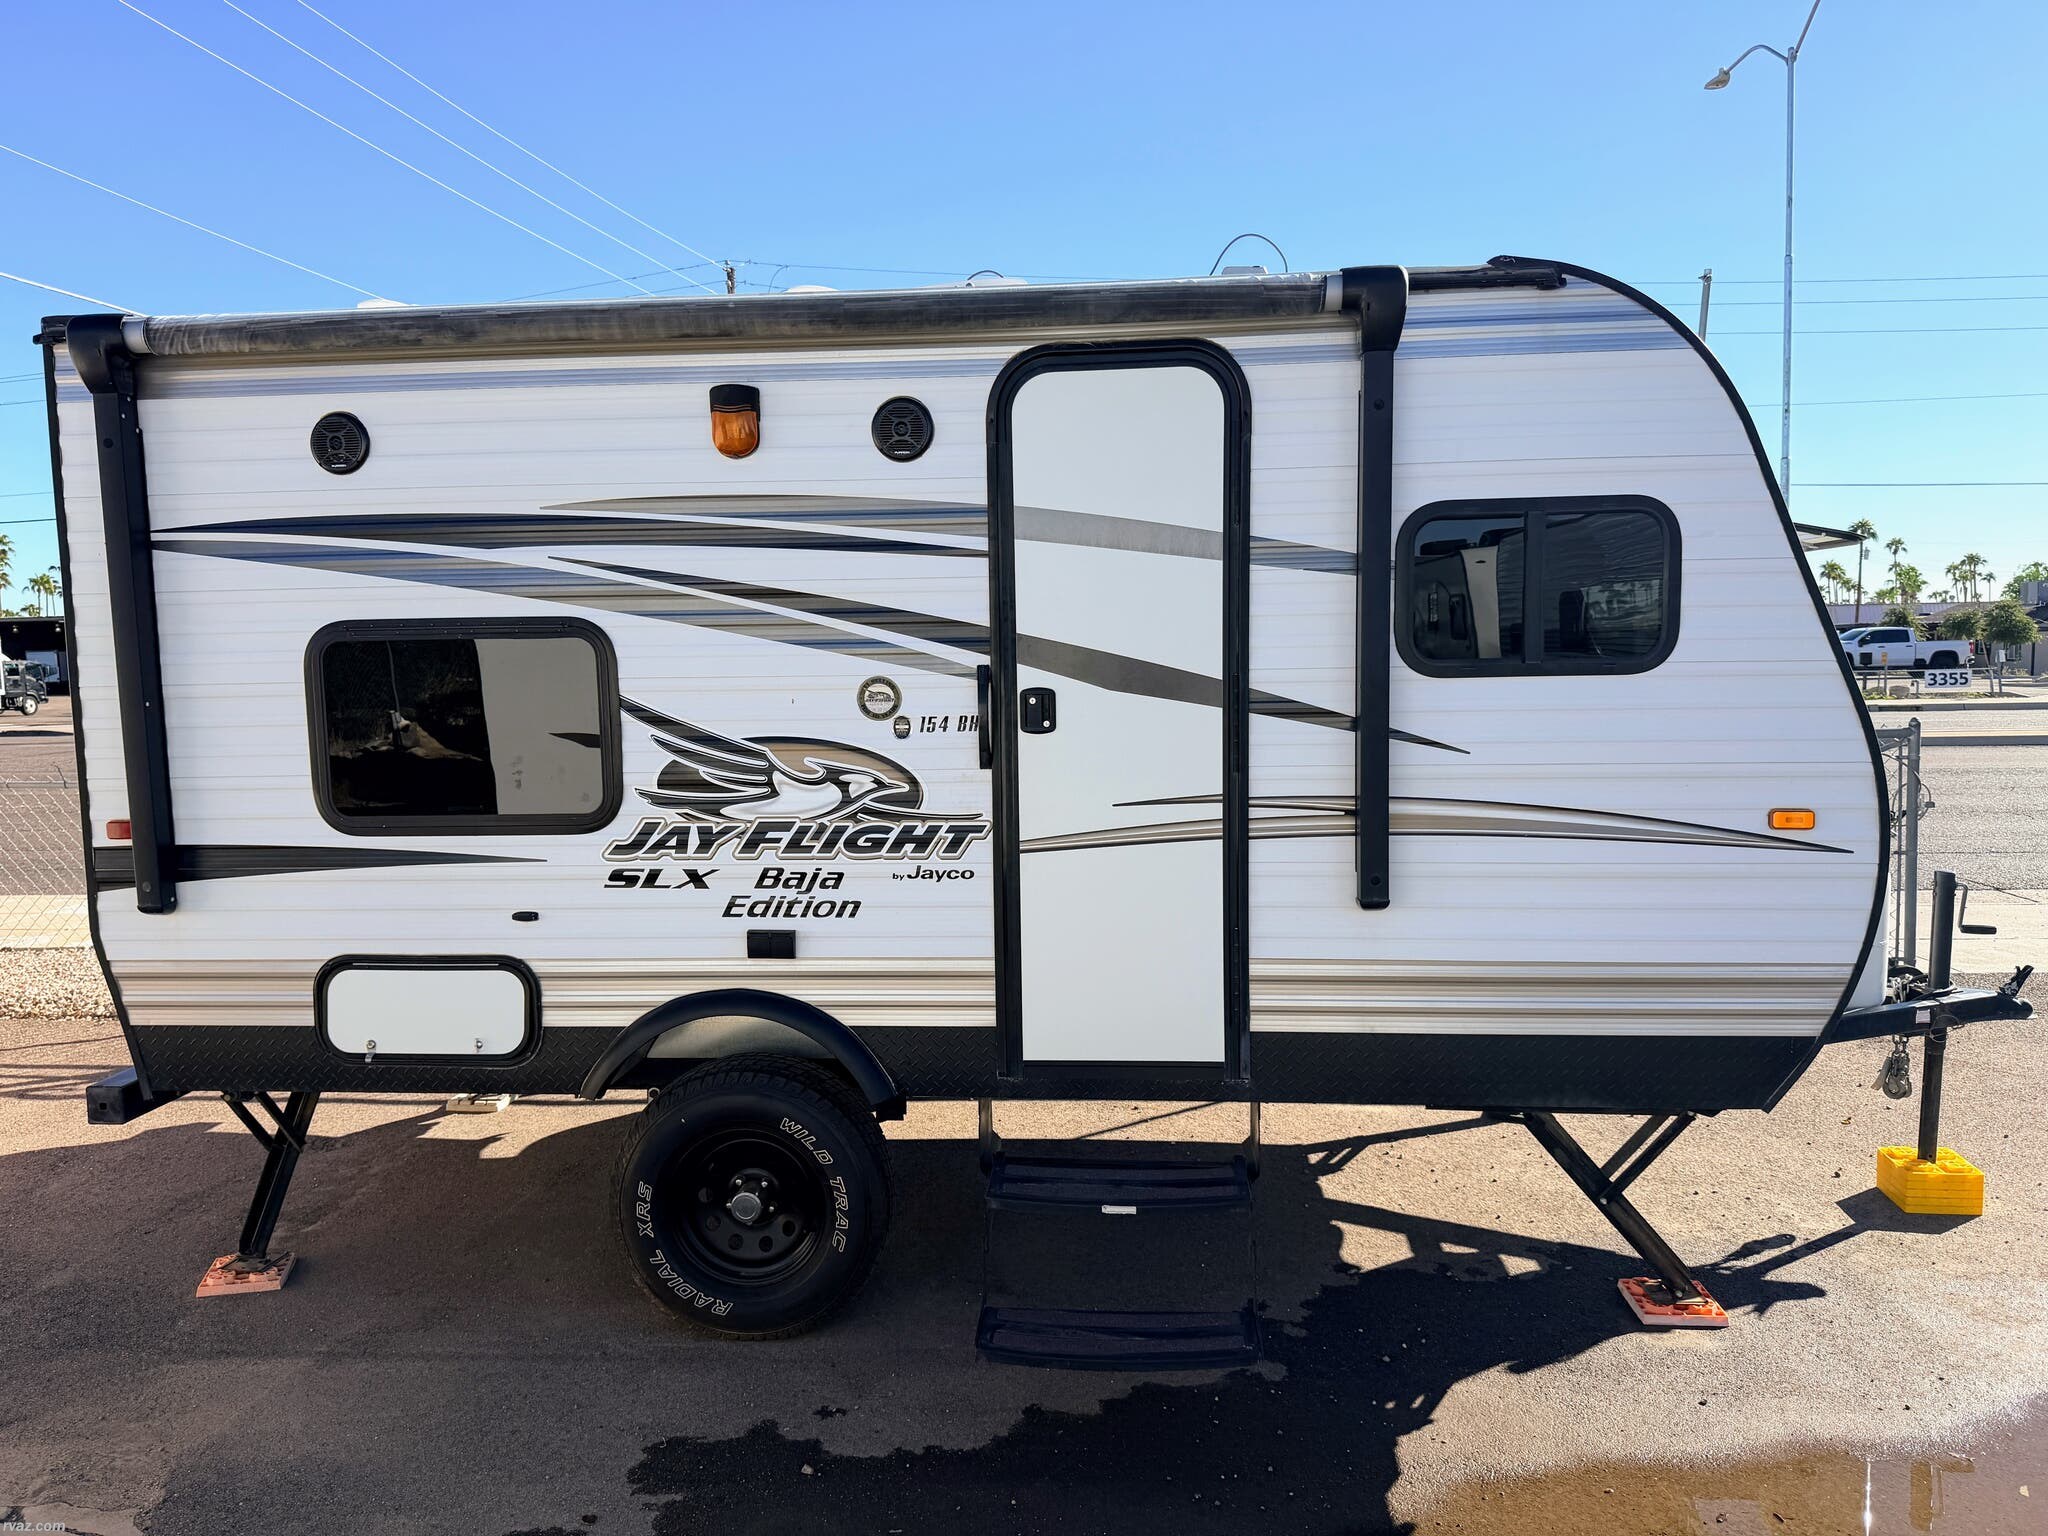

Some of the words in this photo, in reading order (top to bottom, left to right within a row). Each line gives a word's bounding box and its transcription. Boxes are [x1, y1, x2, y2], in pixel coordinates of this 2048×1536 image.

[1927, 672, 1969, 686] 3355
[920, 716, 949, 732] 154
[957, 715, 980, 732] BH
[603, 868, 720, 890] SLX
[754, 867, 845, 895] Baja
[892, 872, 905, 882] by
[906, 865, 975, 881] Jayco
[721, 895, 862, 919] Edition
[780, 1117, 834, 1165] WILD
[829, 1176, 850, 1253] TRAC
[636, 1180, 655, 1239] XRS
[649, 1249, 734, 1316] RADIAL
